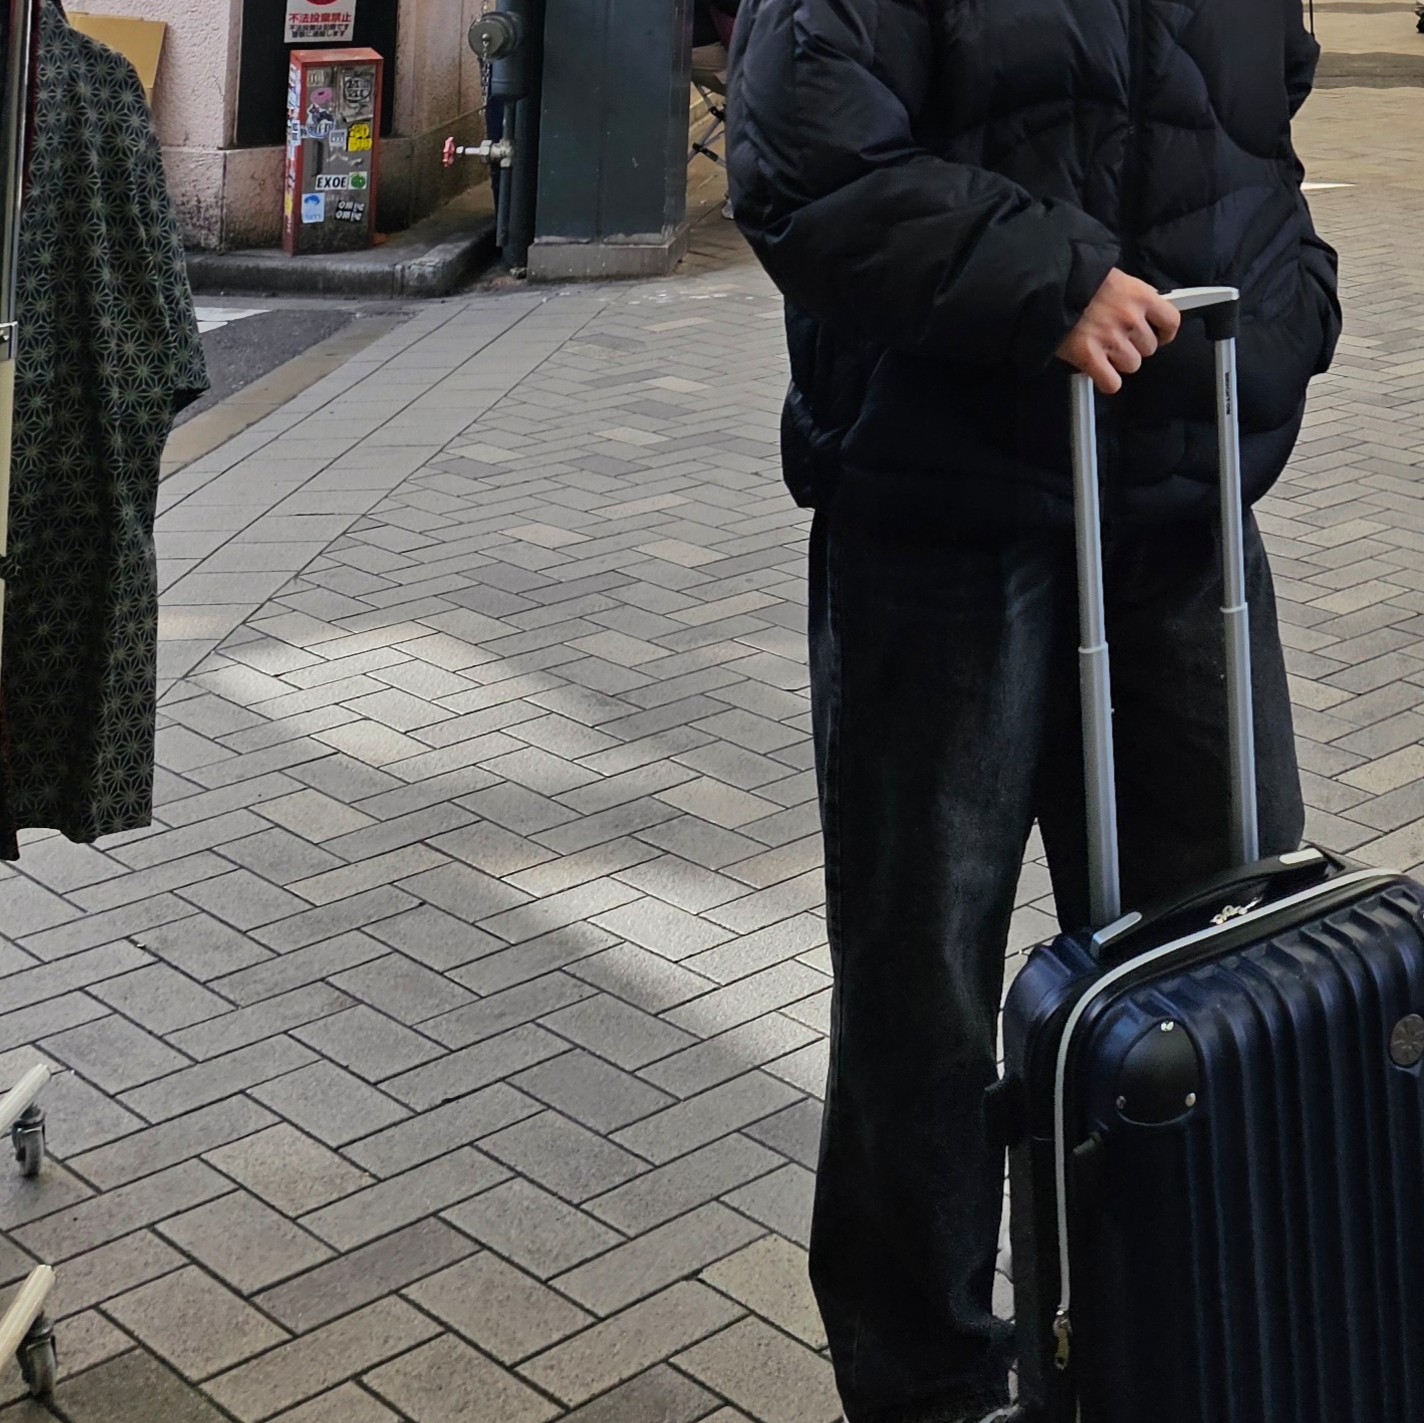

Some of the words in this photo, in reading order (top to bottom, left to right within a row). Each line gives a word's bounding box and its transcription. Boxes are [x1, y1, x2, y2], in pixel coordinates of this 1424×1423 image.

[289, 12, 351, 23] 不法投棄禁止
